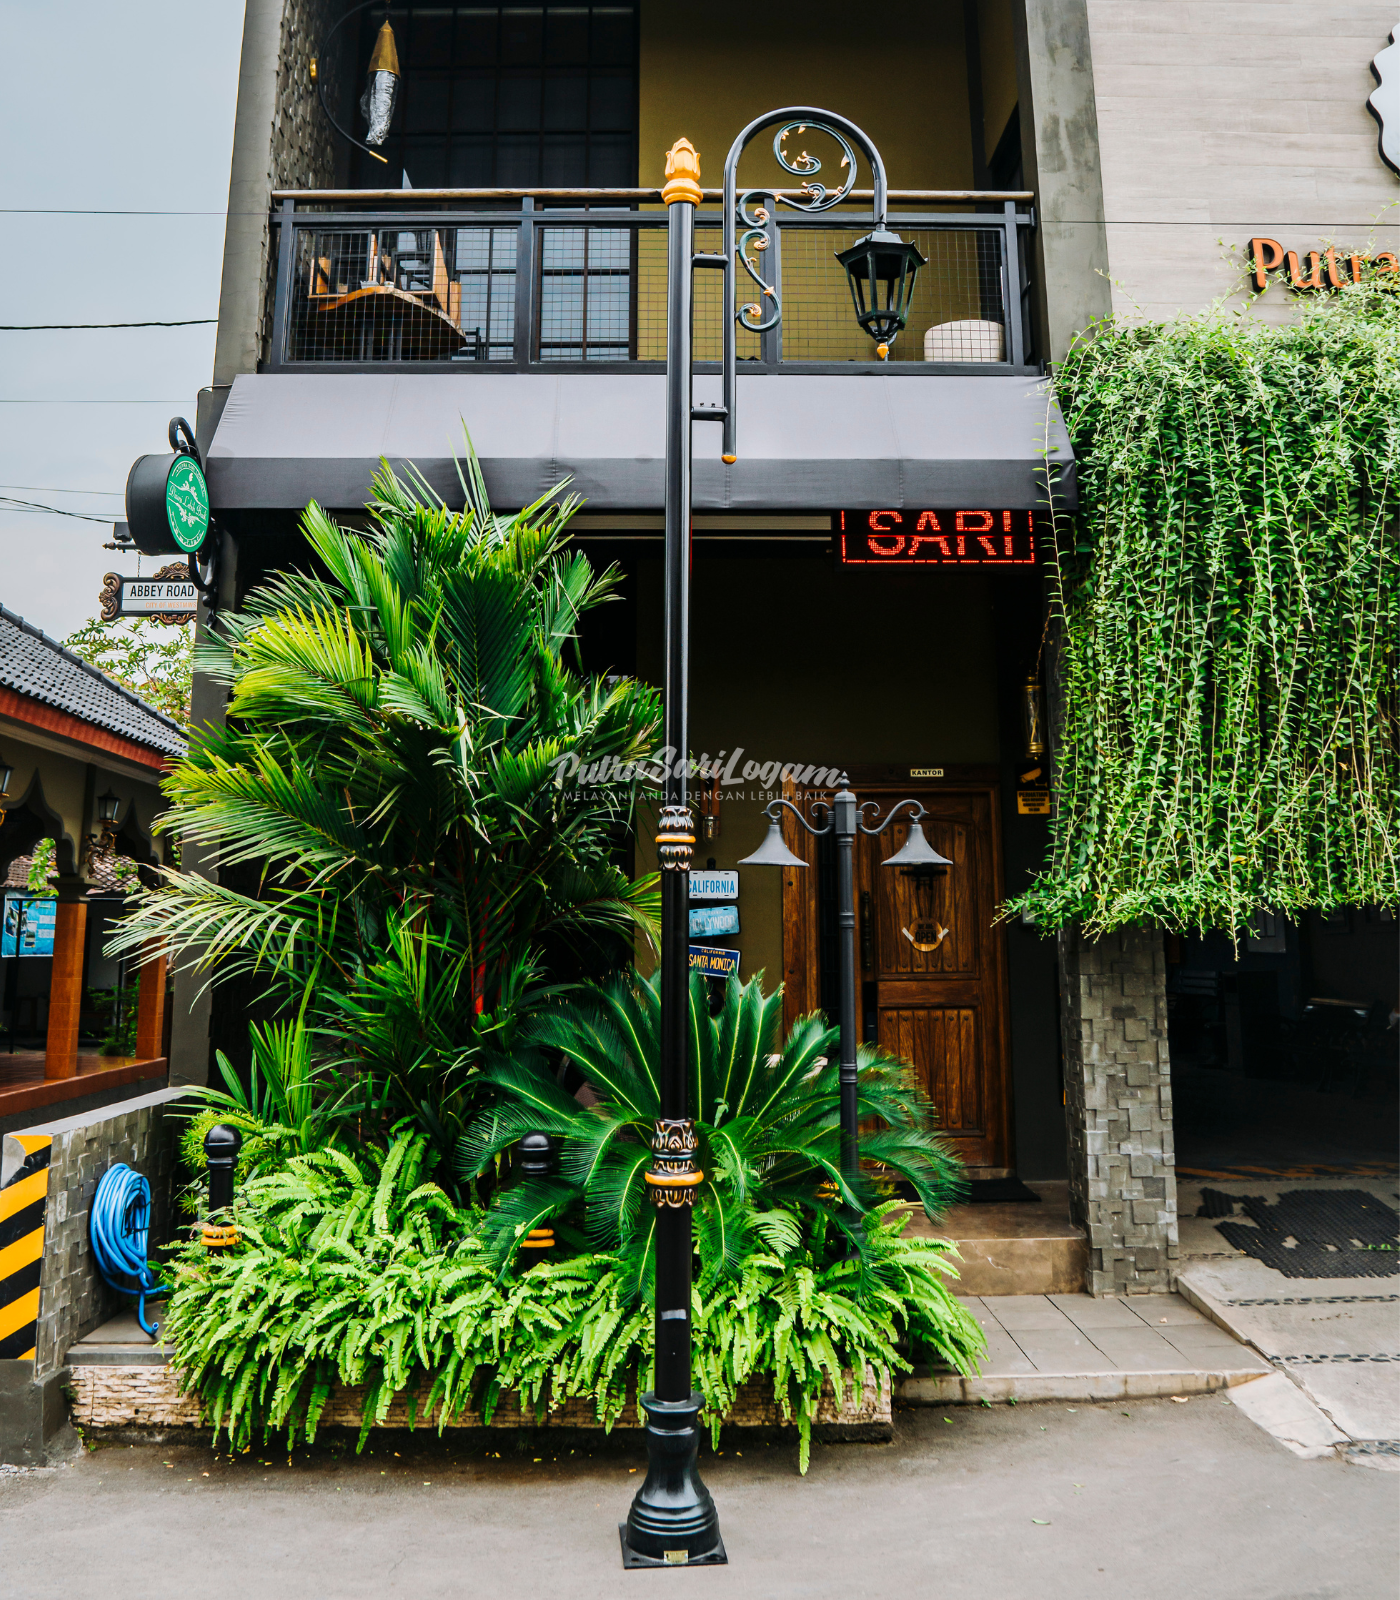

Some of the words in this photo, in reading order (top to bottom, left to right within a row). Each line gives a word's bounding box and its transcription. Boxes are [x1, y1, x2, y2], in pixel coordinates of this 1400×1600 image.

[1249, 237, 1399, 292] Putra
[868, 510, 1014, 556] SARI
[130, 585, 164, 597] ABBEY
[166, 585, 195, 597] ROAD
[689, 880, 735, 893] CALIFORNIA
[915, 931, 937, 943] OPEN
[689, 954, 709, 969] SANTA
